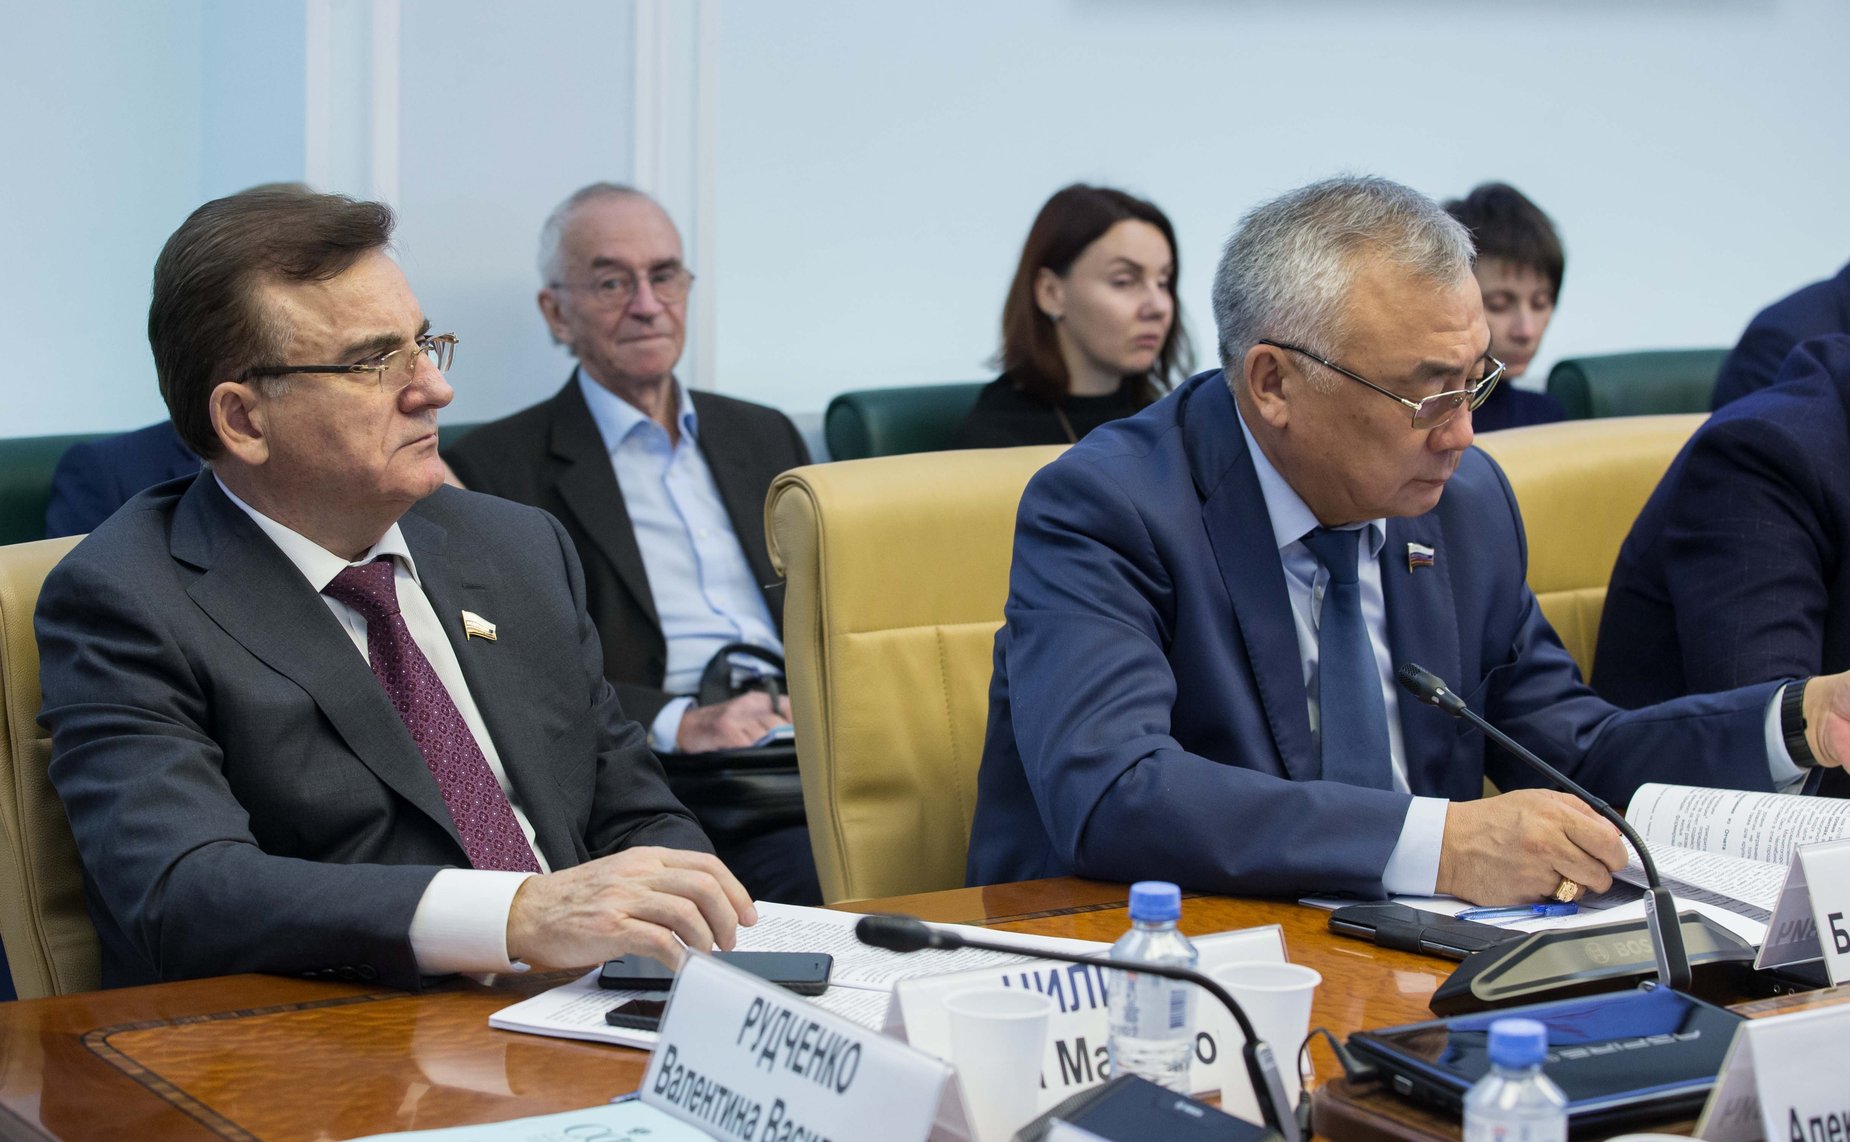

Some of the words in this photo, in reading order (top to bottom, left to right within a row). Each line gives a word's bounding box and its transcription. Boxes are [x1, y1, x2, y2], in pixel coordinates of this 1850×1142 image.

[1614, 939, 1655, 957] BOS
[654, 1044, 760, 1141] Валентина
[761, 1098, 835, 1142] Вас
[737, 997, 862, 1094] РУДЧЕНКО
